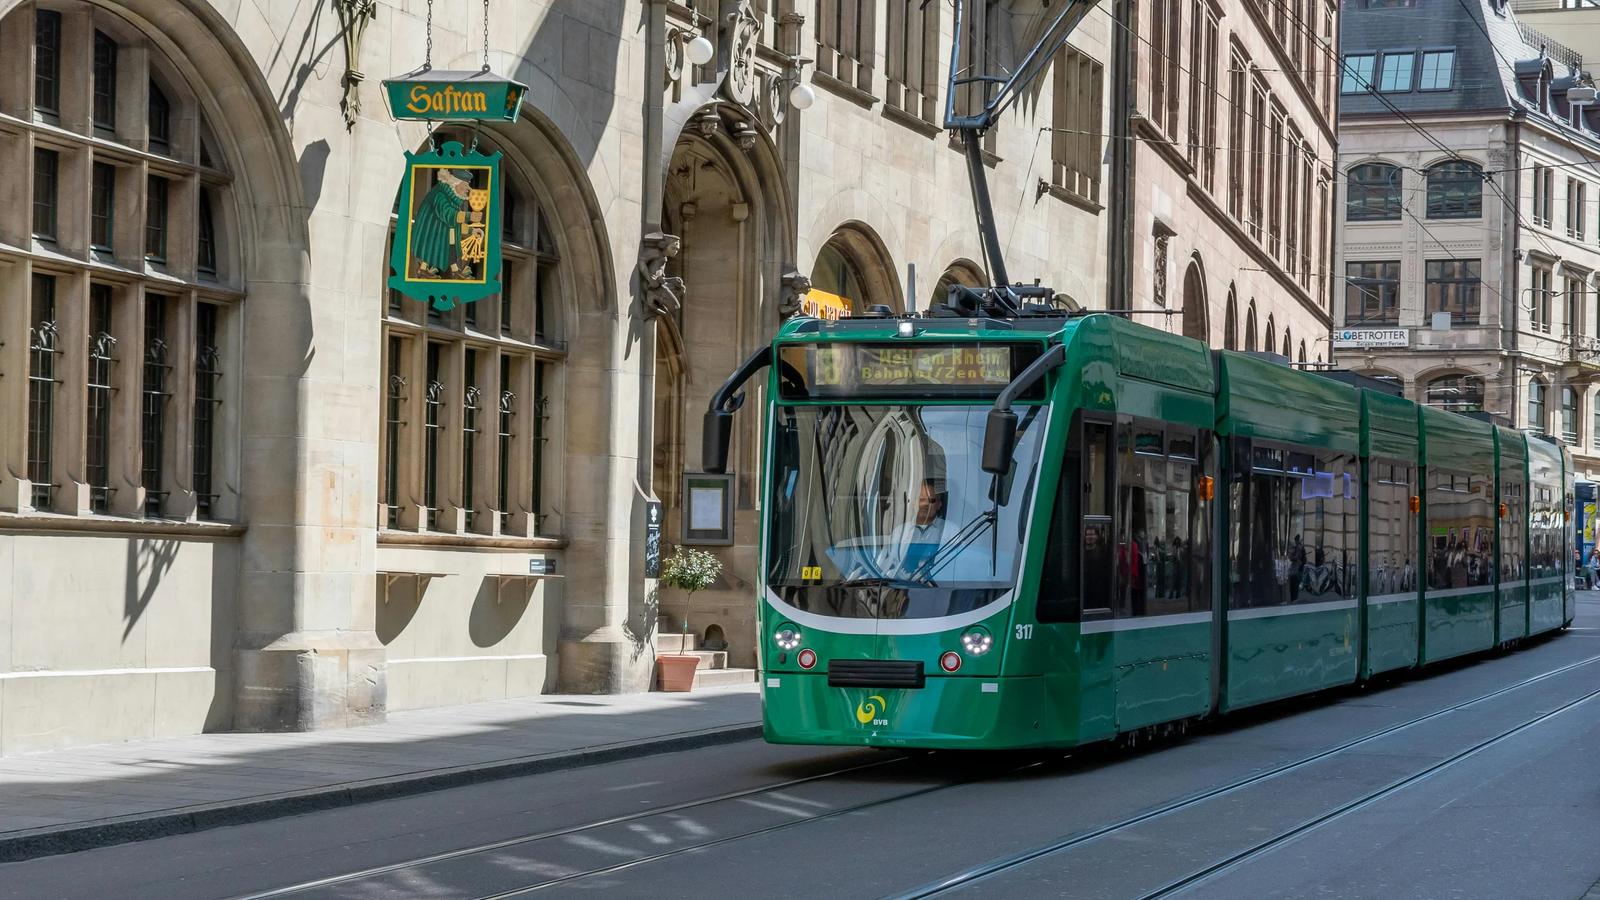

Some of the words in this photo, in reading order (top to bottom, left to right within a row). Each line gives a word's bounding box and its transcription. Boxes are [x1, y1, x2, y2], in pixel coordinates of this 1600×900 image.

[407, 84, 487, 113] Safran
[1333, 330, 1406, 340] GLOBETROTTER
[1015, 623, 1033, 640] 317
